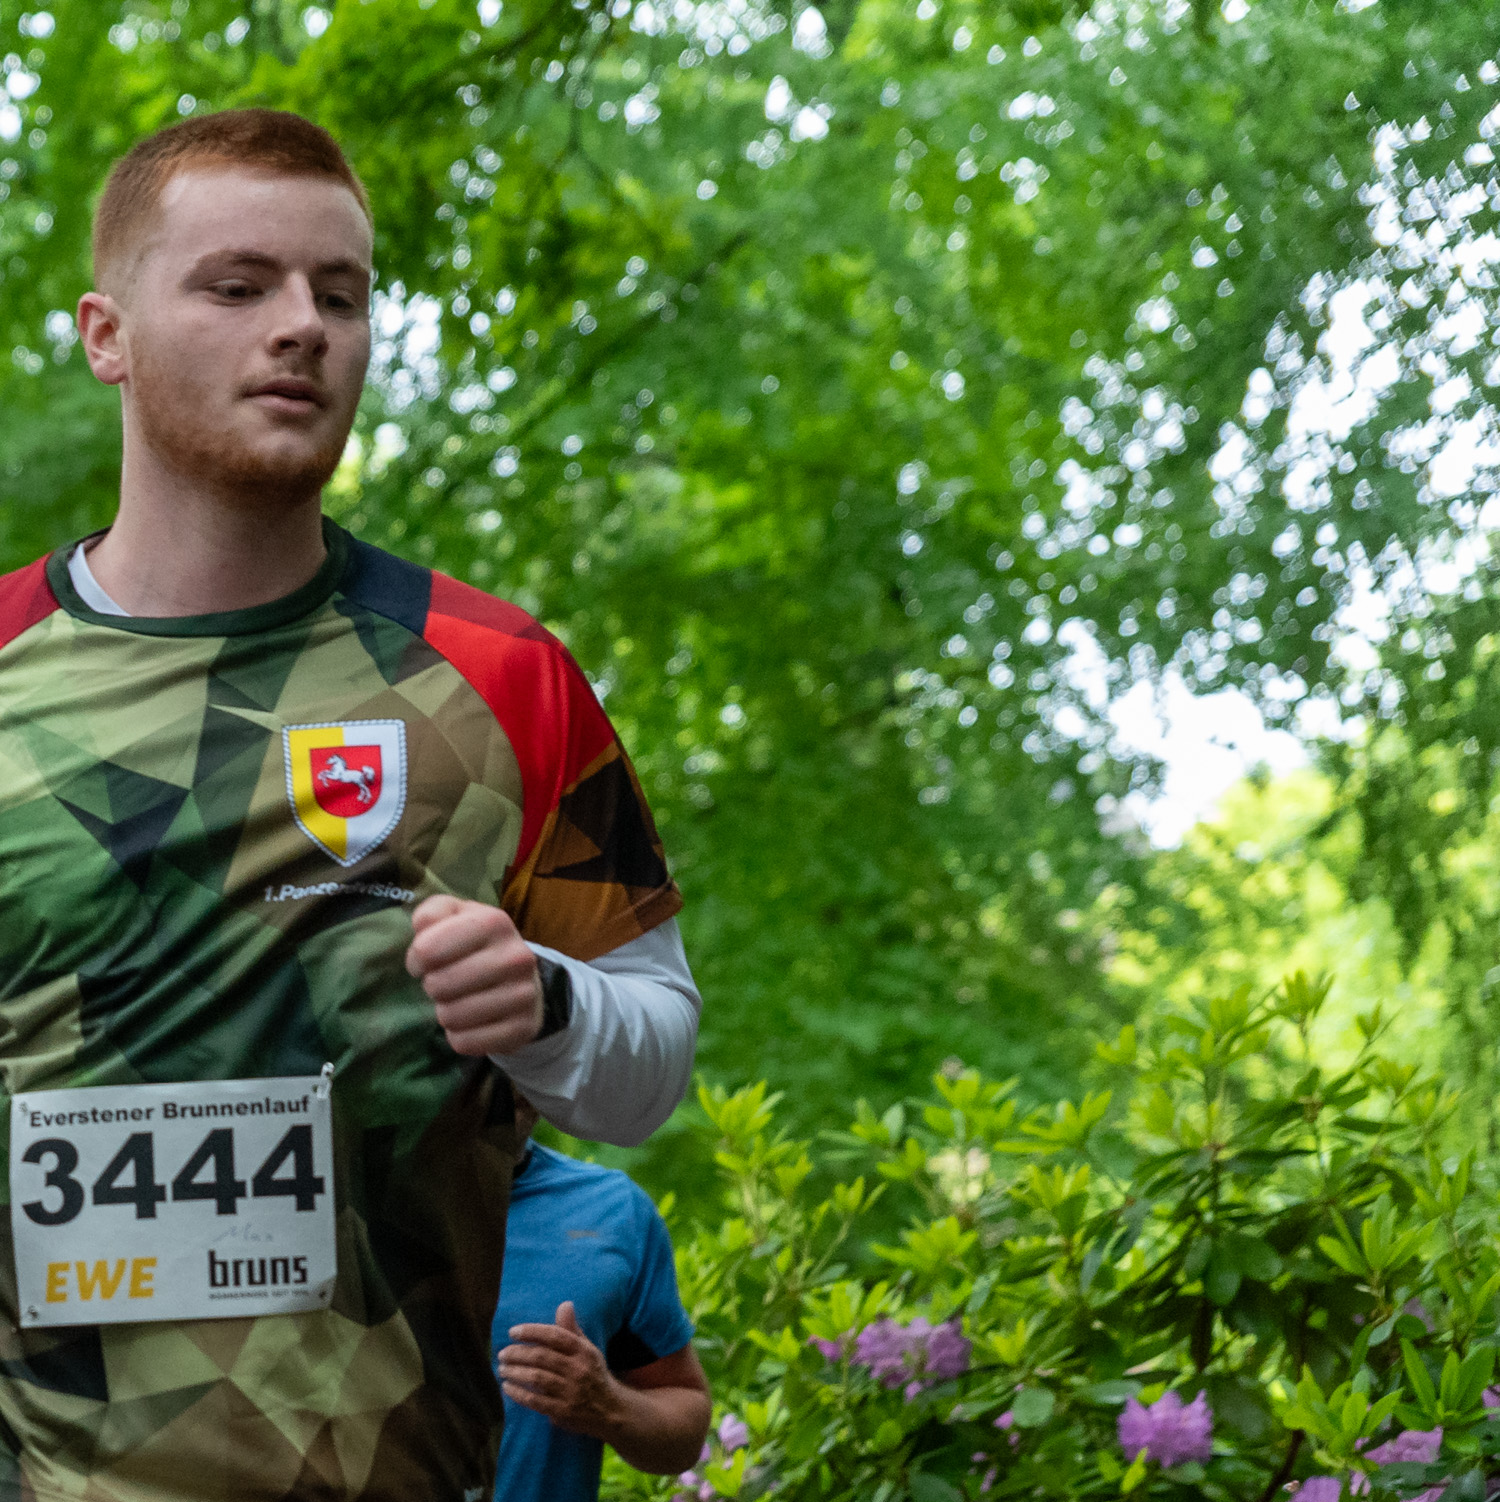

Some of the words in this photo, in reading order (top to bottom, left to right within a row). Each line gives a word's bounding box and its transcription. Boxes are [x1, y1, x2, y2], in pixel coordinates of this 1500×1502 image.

[29, 1106, 155, 1128] Everstener
[162, 1095, 310, 1119] Brunnenlauf
[21, 1124, 325, 1227] 3444
[45, 1257, 158, 1304] EWE
[208, 1249, 308, 1288] bruns
